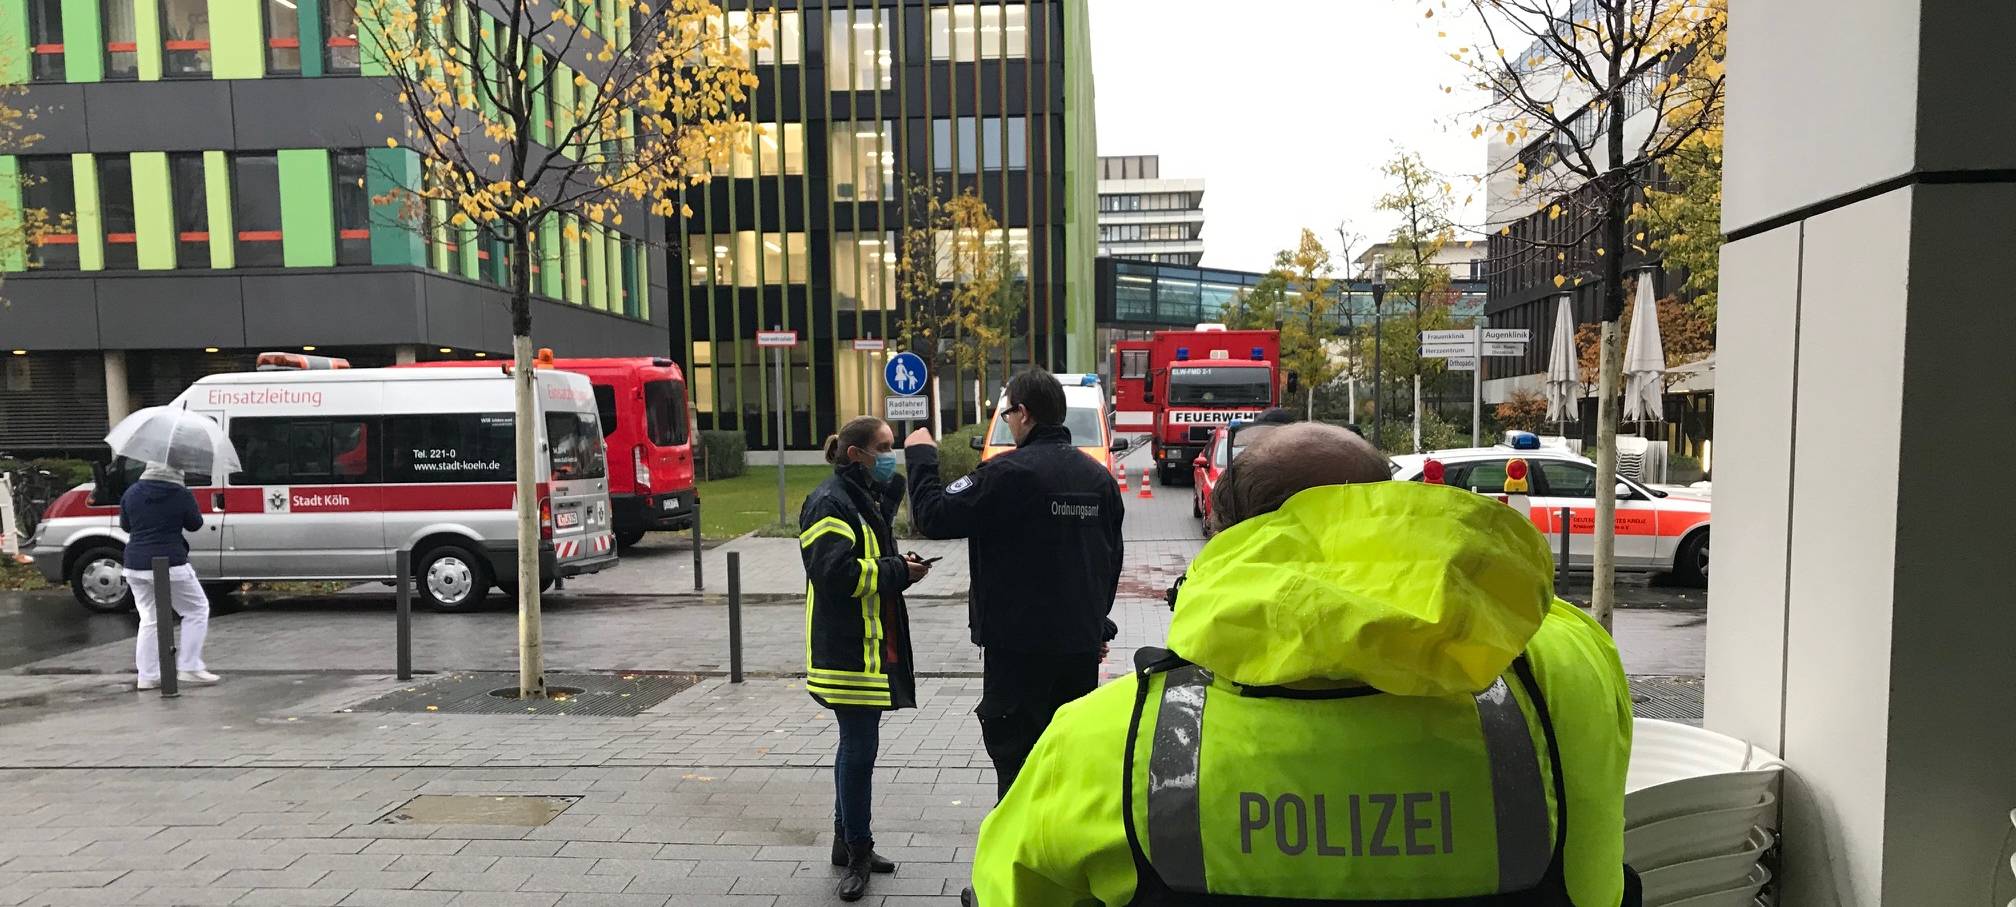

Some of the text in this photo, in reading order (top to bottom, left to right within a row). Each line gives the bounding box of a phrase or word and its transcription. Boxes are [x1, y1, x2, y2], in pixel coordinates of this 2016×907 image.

[1485, 331, 1528, 339] Augenklinik
[208, 388, 322, 408] Einsatzleitung
[1176, 413, 1255, 422] FEUERWEH
[413, 449, 456, 458] Tel. 221-0
[413, 460, 500, 471] www.stadt-koeln.de
[293, 495, 350, 506] Stadt Köln
[1051, 501, 1099, 519] Ordnungsamt
[1239, 791, 1454, 857] POLIZEI
